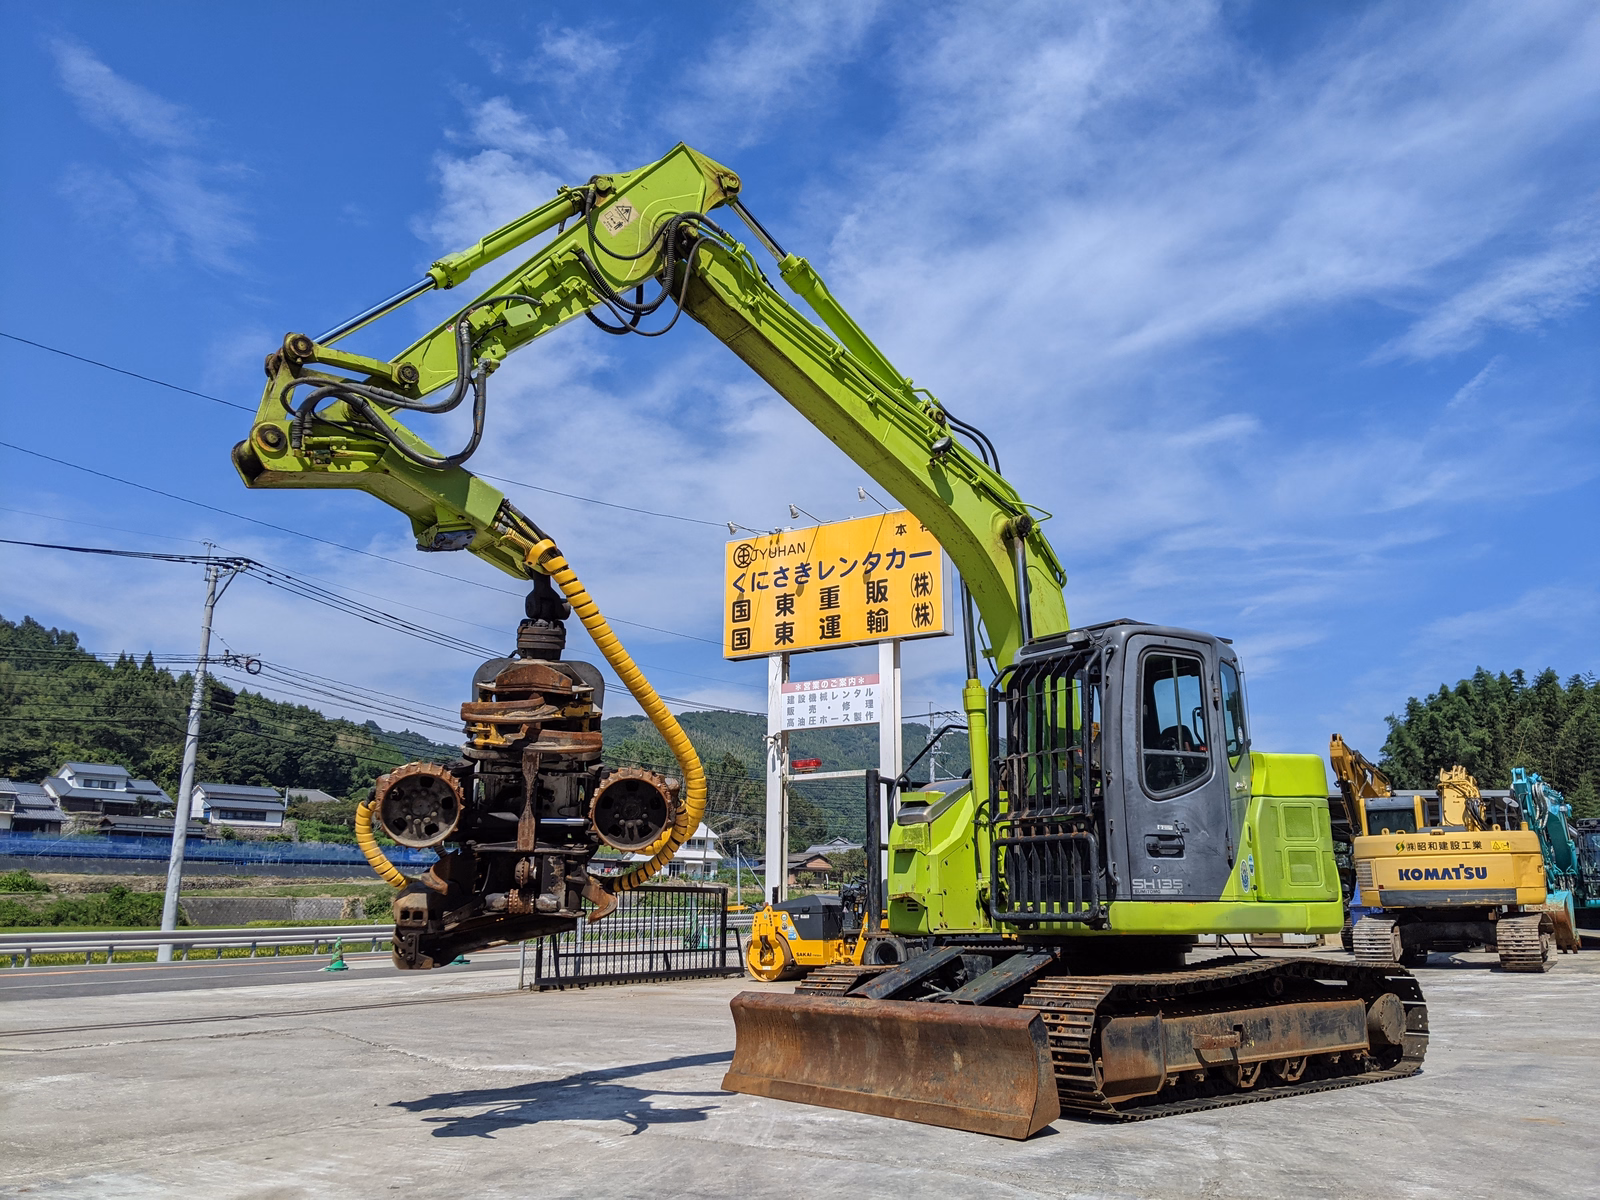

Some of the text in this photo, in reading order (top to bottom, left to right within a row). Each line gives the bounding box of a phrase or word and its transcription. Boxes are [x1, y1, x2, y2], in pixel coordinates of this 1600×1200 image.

[750, 542, 806, 562] JYUHAN
[732, 547, 933, 593] くにさきレンタカー
[786, 687, 874, 705] 建設機械レンタル
[786, 711, 874, 728] 高油圧ホース製作
[1397, 863, 1488, 881] KOMATSU
[1132, 878, 1184, 889] SH135
